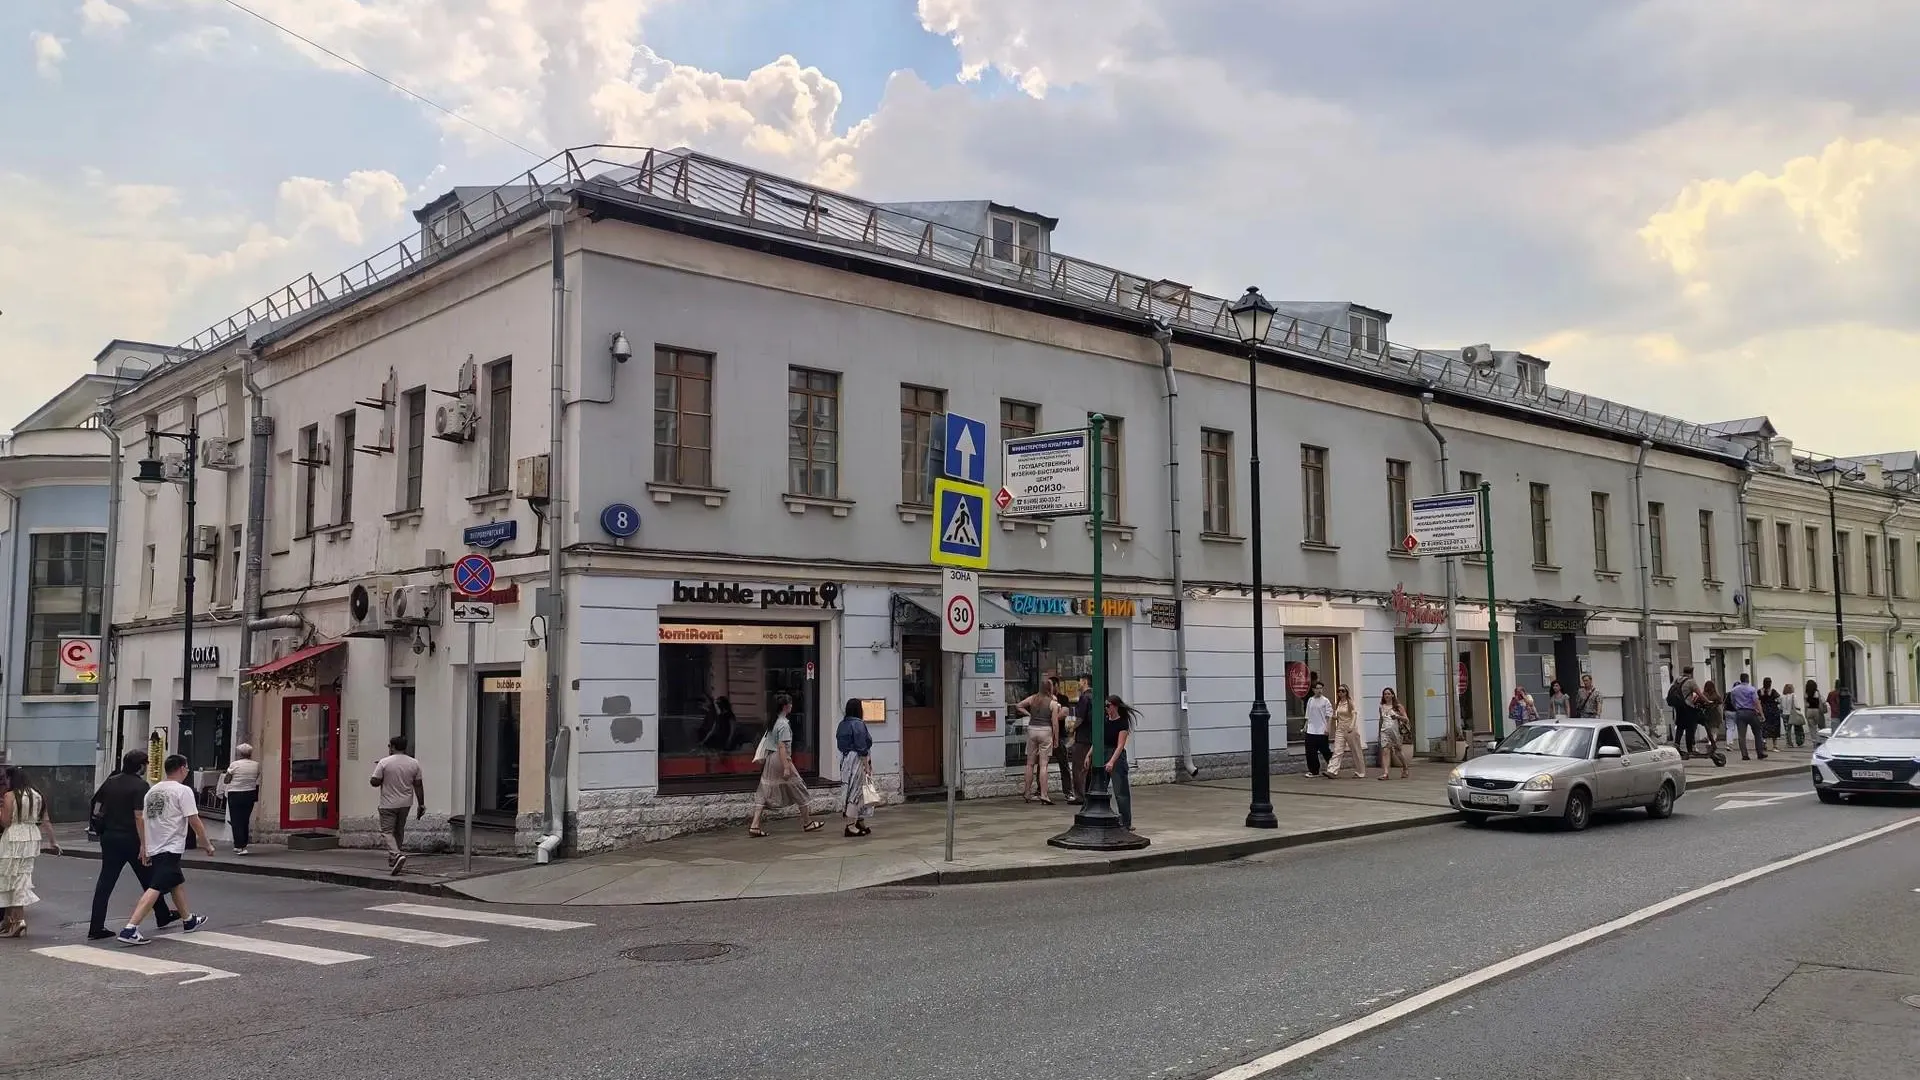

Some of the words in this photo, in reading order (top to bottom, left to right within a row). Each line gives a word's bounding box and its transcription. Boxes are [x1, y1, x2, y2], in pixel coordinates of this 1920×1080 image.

[1018, 459, 1072, 470] ГОСУДАРСТВЕННЫЙ
[1011, 466, 1080, 477] МУЗЕЙНО-ВЫСТАВОЧНЫЙ
[617, 511, 628, 529] 8
[950, 570, 972, 581] ЗОНА
[673, 581, 754, 604] bubble
[761, 585, 820, 609] point
[953, 607, 969, 623] 30
[659, 628, 724, 640] RomiRomi
[496, 679, 515, 689] bubble
